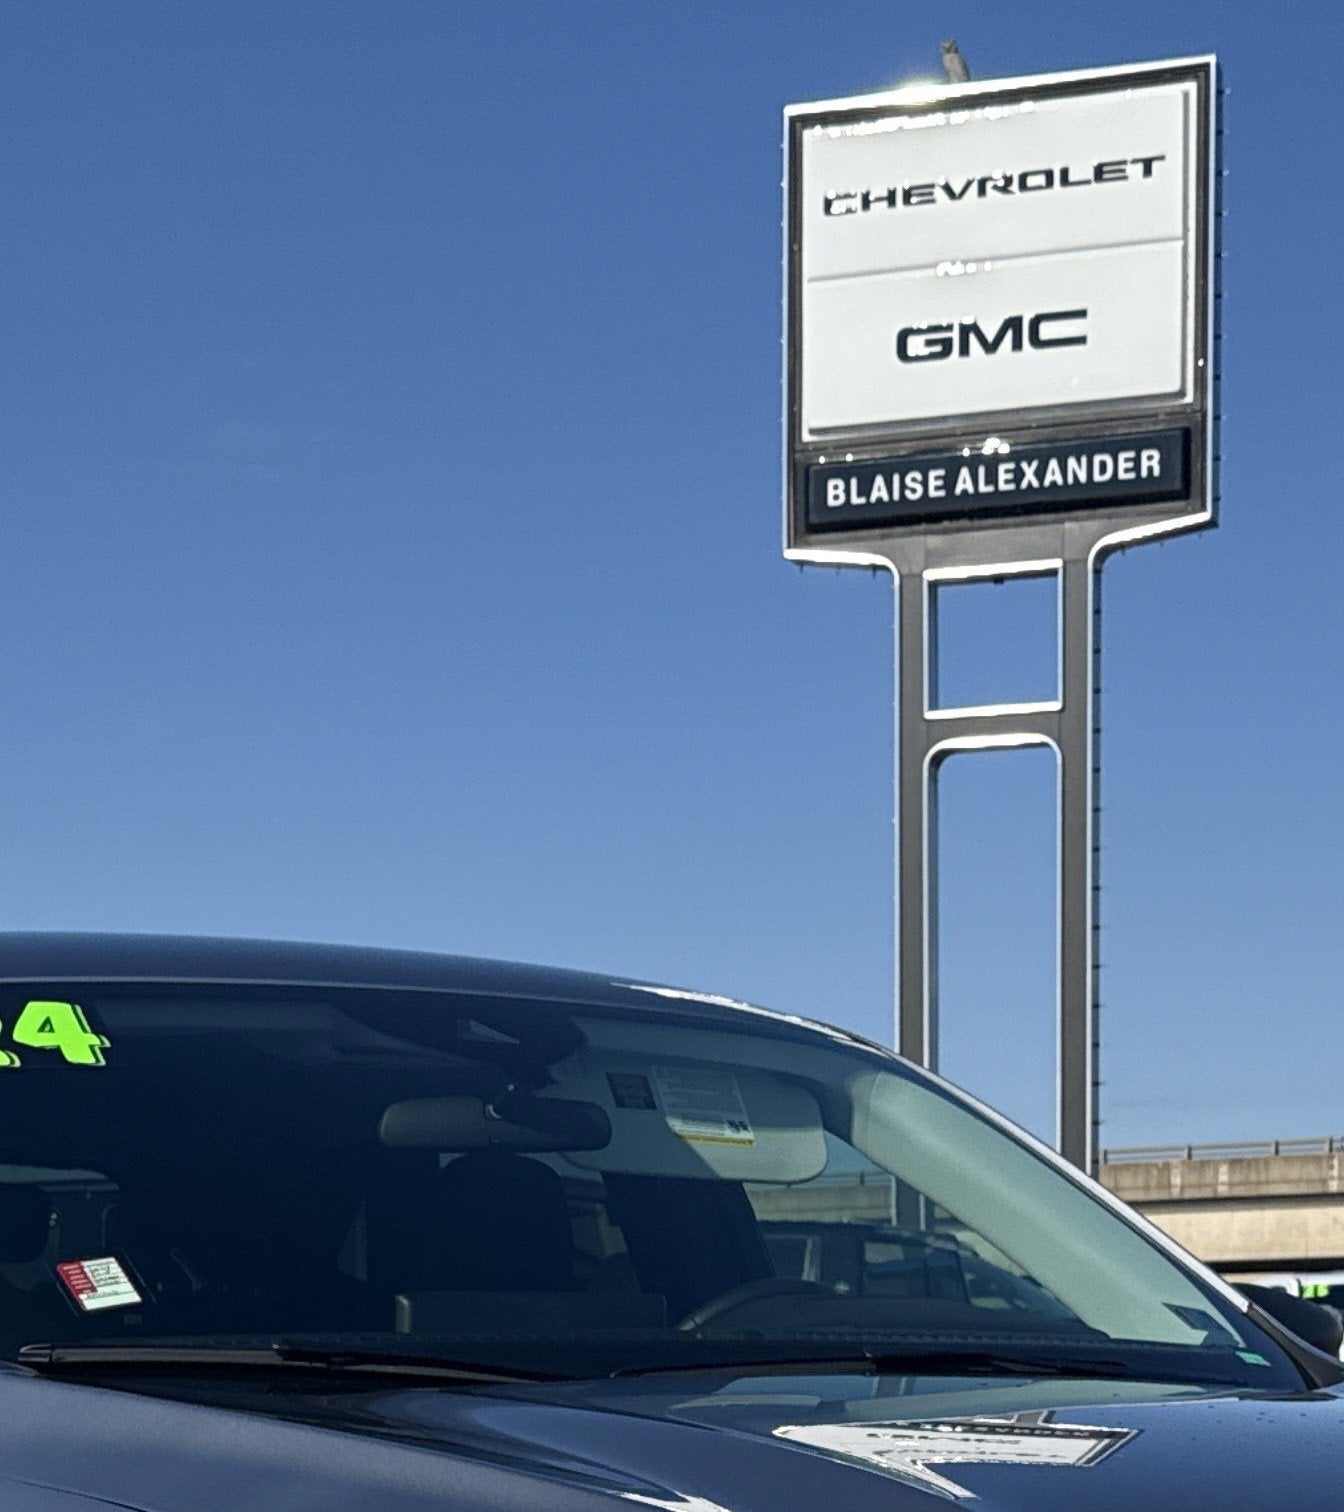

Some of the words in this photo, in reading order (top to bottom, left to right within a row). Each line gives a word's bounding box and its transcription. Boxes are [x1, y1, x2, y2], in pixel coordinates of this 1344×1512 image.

[823, 154, 1166, 217] CHEVROLET
[896, 308, 1088, 363] GMC
[826, 469, 947, 507] BLAISE
[954, 448, 1161, 496] ALEXANDER
